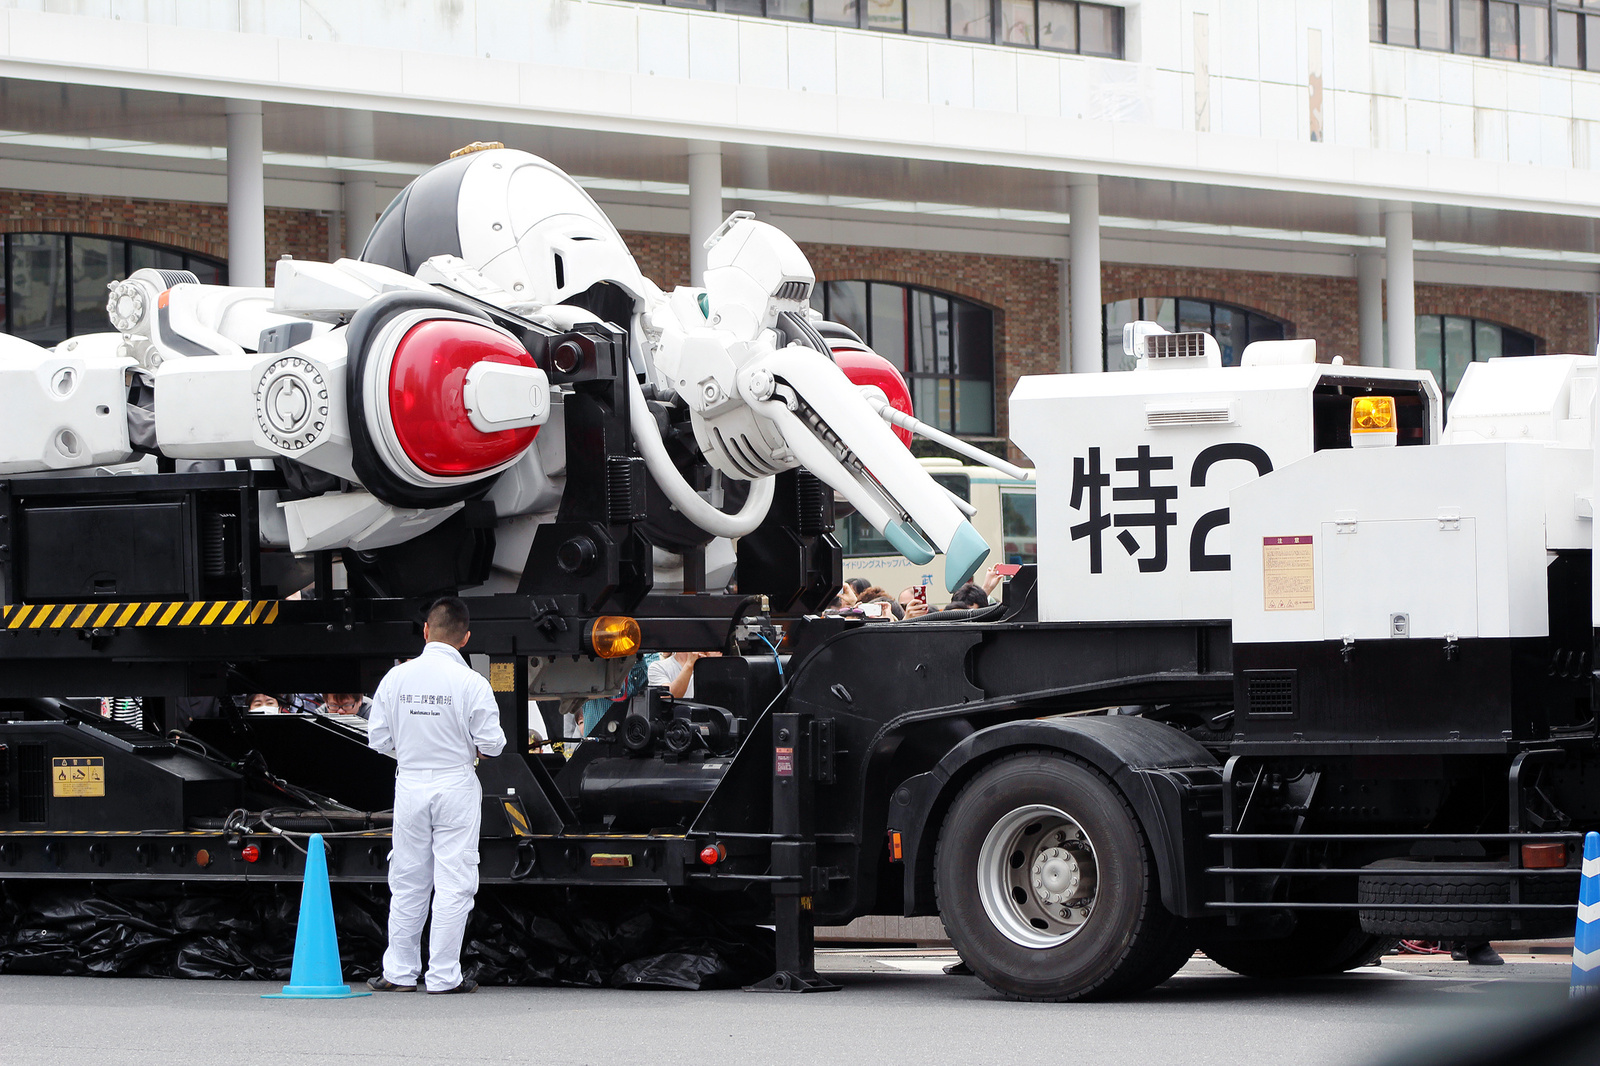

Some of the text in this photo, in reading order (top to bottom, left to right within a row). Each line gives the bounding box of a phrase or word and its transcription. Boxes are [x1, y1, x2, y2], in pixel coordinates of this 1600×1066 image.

[843, 559, 912, 569] イドリングストップバス
